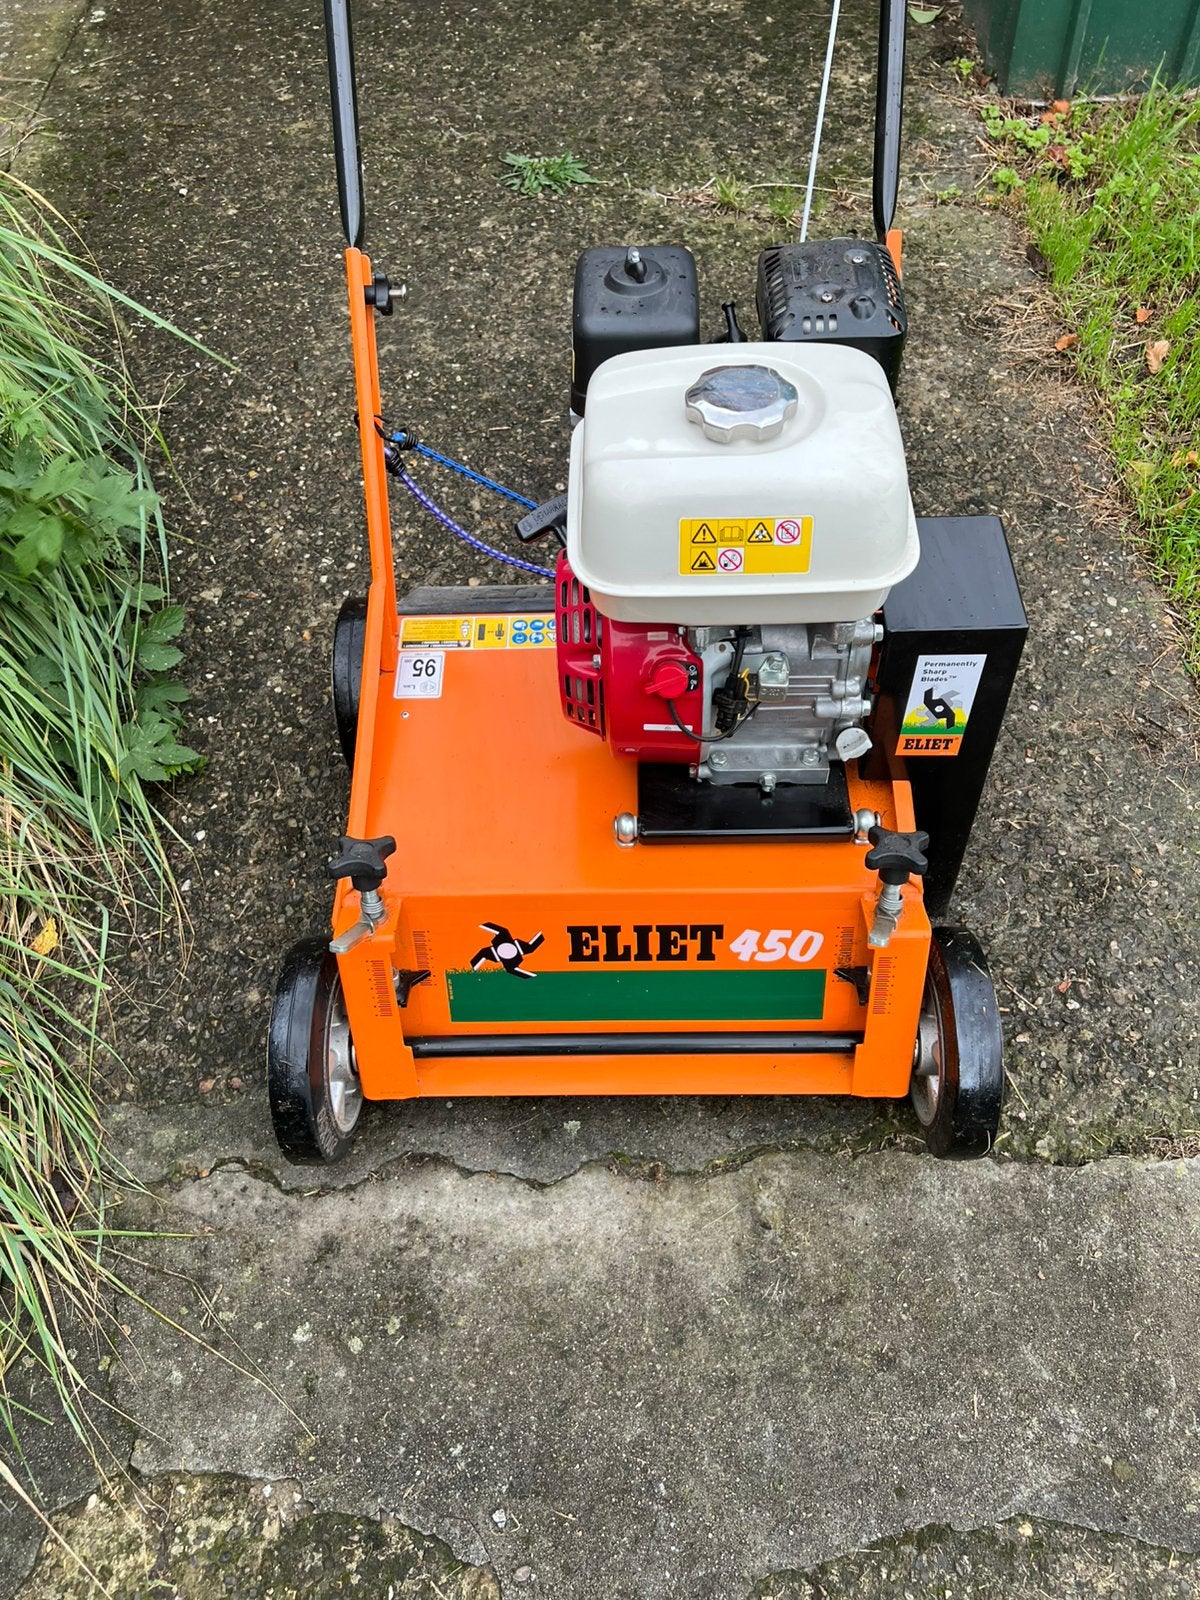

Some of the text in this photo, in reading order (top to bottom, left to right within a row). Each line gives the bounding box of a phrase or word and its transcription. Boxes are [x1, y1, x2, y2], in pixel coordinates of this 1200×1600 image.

[412, 658, 437, 677] 95
[903, 738, 953, 750] ELIET
[566, 924, 824, 963] ELIET 450
